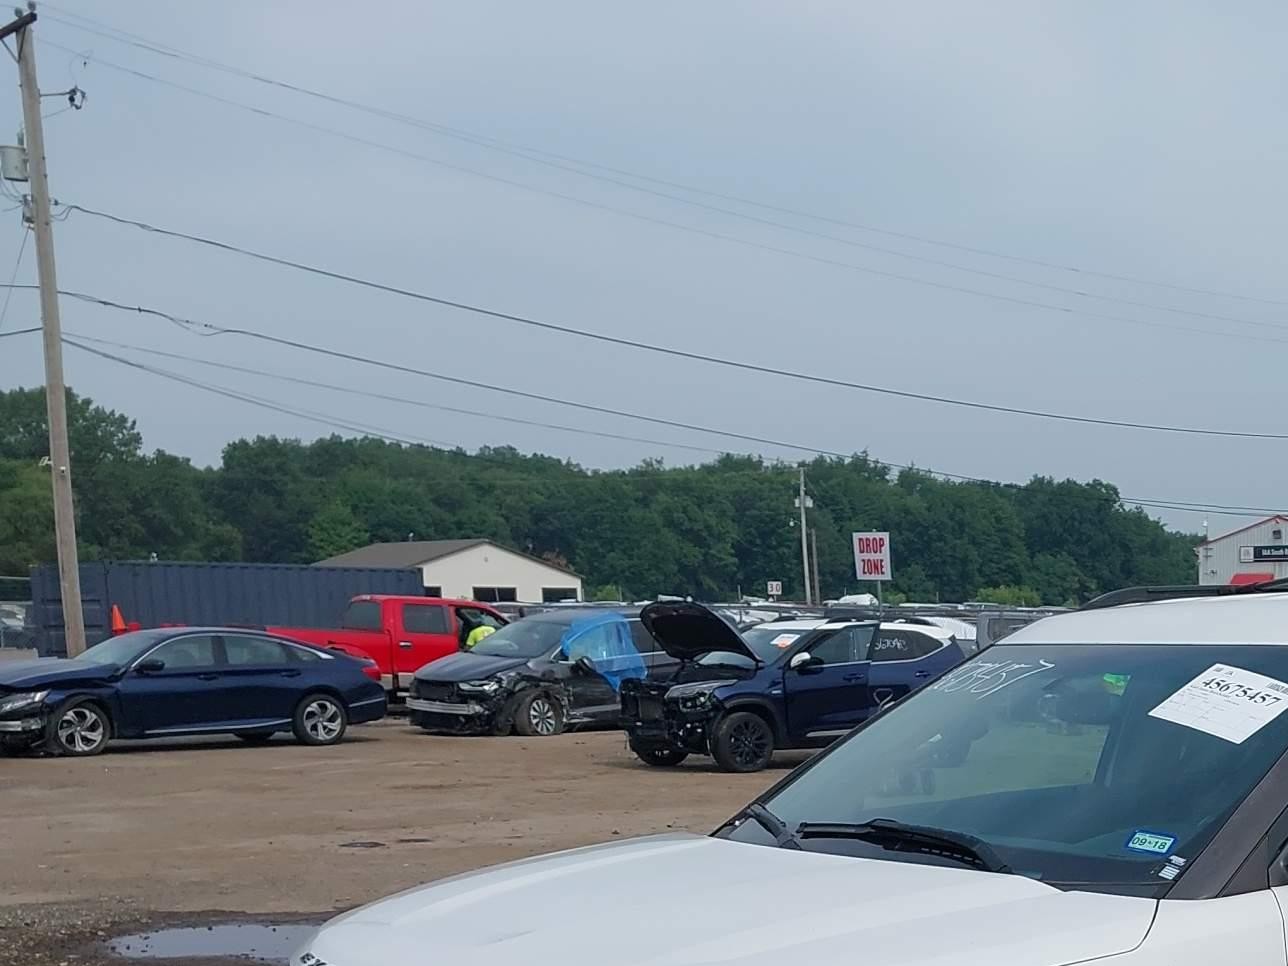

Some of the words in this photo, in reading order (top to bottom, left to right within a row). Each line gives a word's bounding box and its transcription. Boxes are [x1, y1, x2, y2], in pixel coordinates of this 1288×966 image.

[858, 537, 885, 554] DROP
[861, 559, 885, 575] ZONE
[1202, 678, 1282, 707] 45675457
